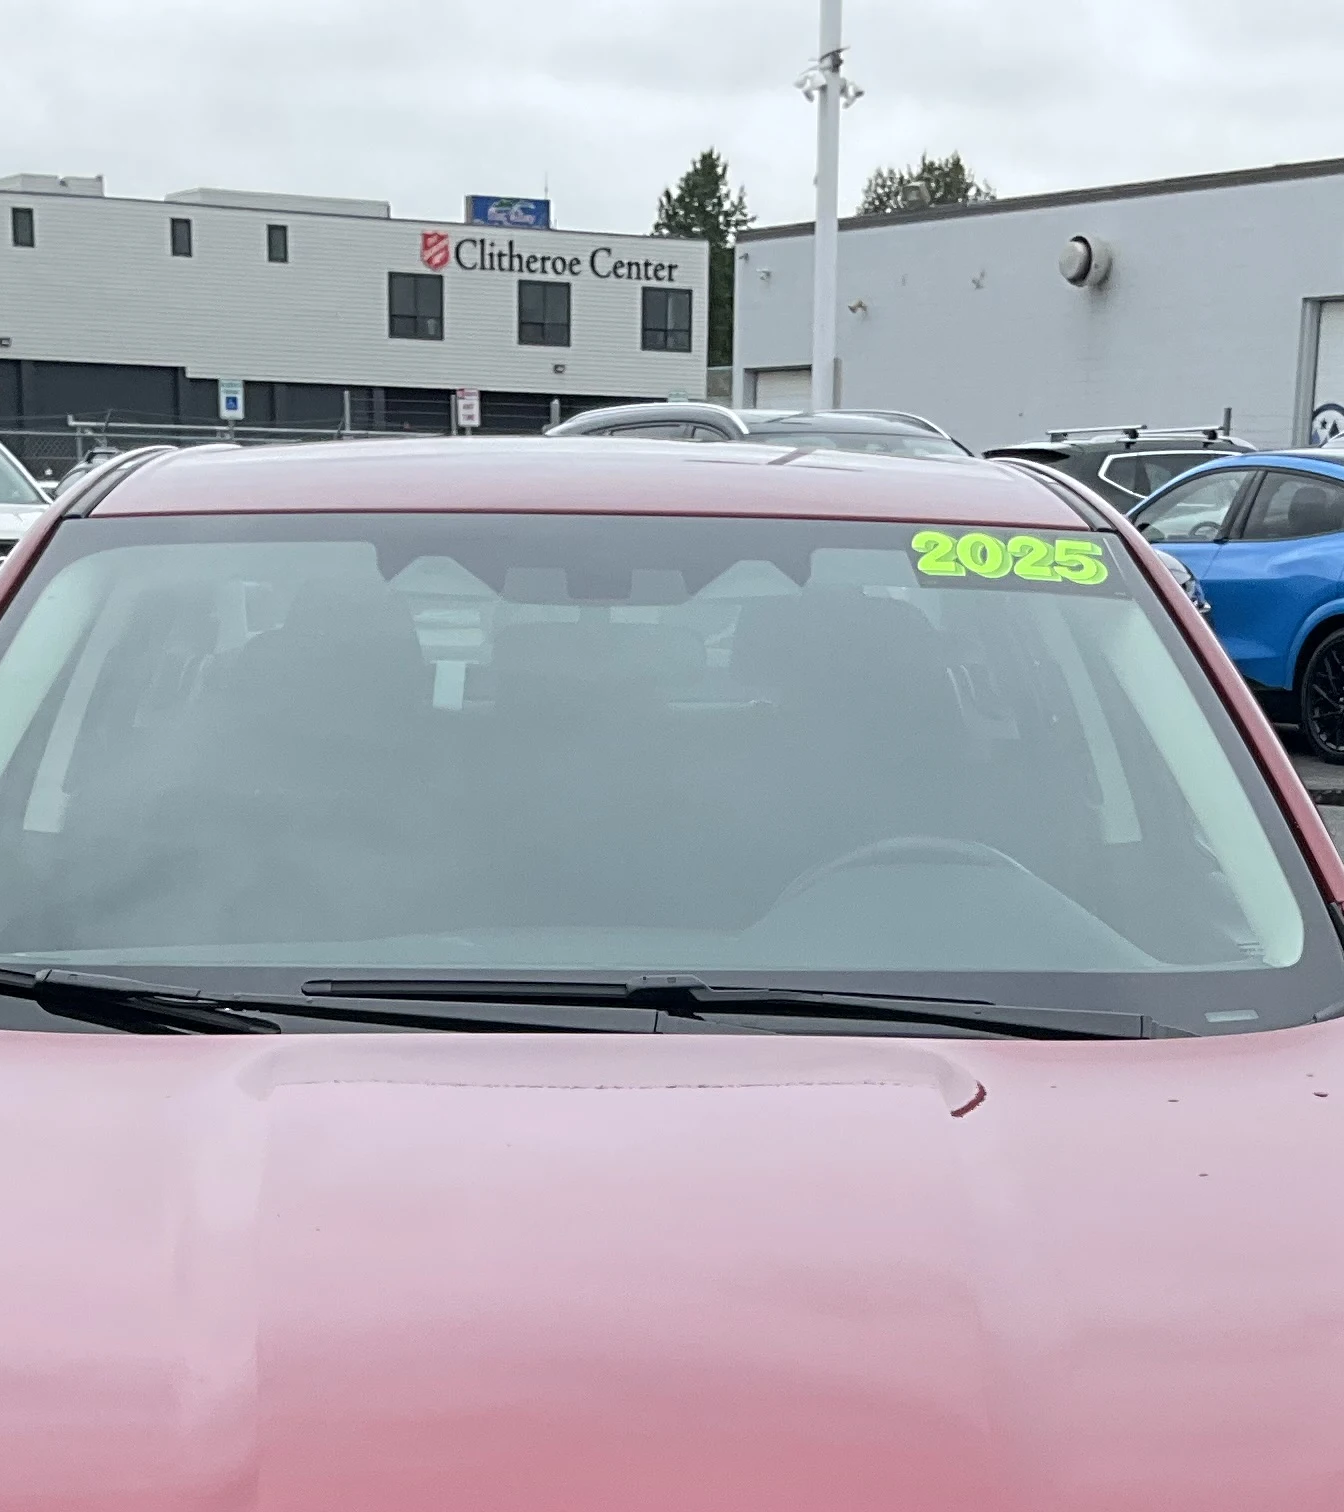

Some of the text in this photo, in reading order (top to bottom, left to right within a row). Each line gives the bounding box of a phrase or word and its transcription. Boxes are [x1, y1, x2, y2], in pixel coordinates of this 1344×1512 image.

[454, 238, 582, 276] Clitheroe
[589, 247, 678, 282] Center
[911, 531, 1109, 585] 2025
